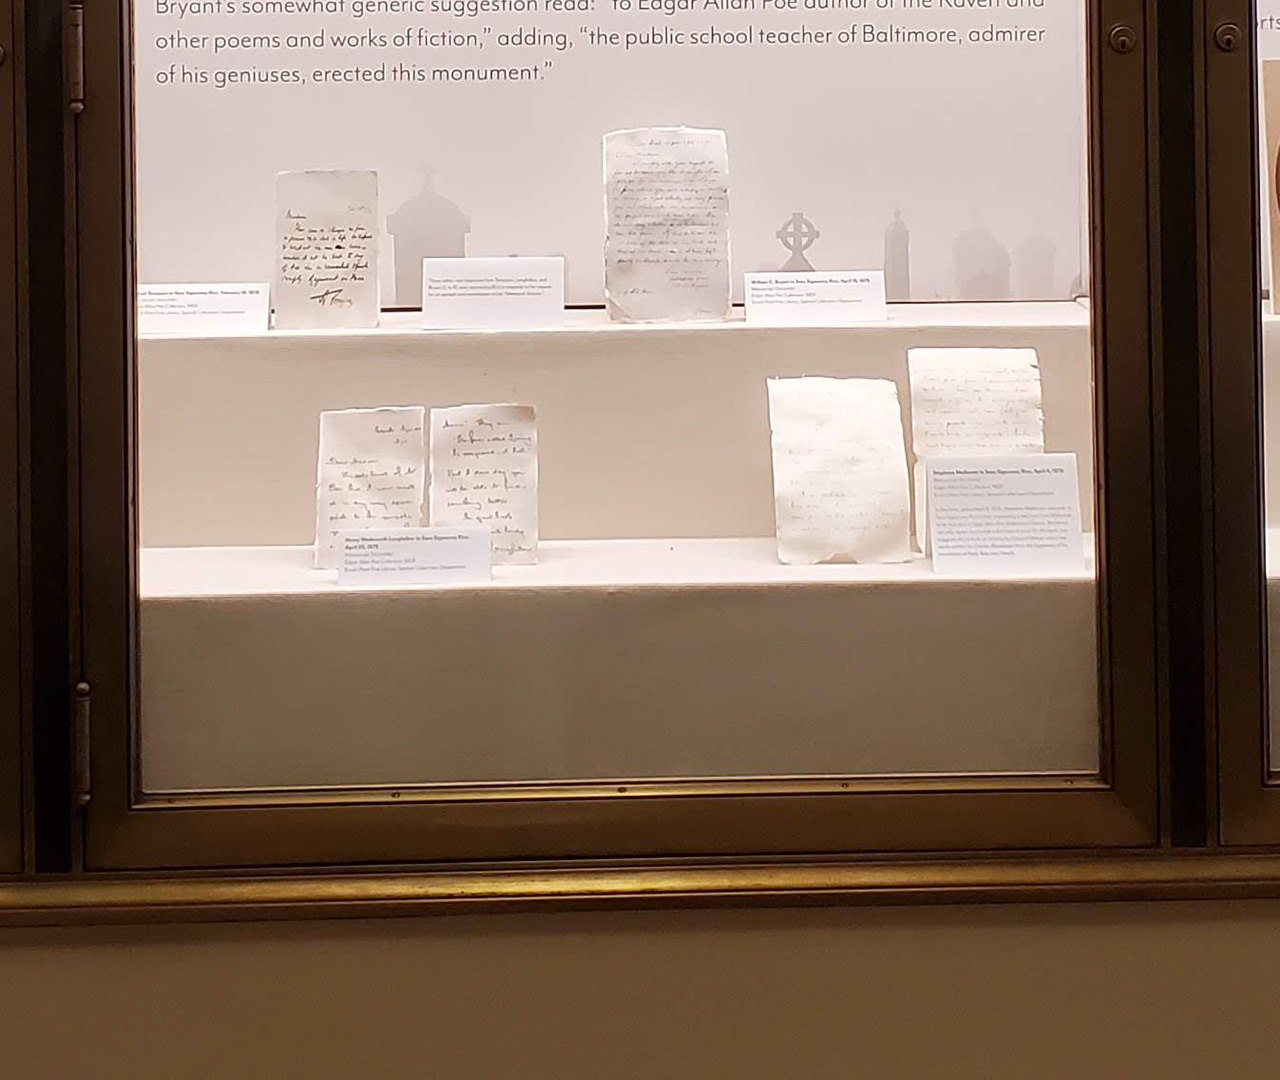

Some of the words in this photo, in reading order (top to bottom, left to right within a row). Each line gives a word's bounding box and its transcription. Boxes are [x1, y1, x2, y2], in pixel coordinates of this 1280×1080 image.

[155, 63, 177, 84] of
[181, 63, 209, 84] his
[214, 65, 306, 89] geniuses,
[312, 61, 386, 83] erected
[391, 62, 426, 82] this
